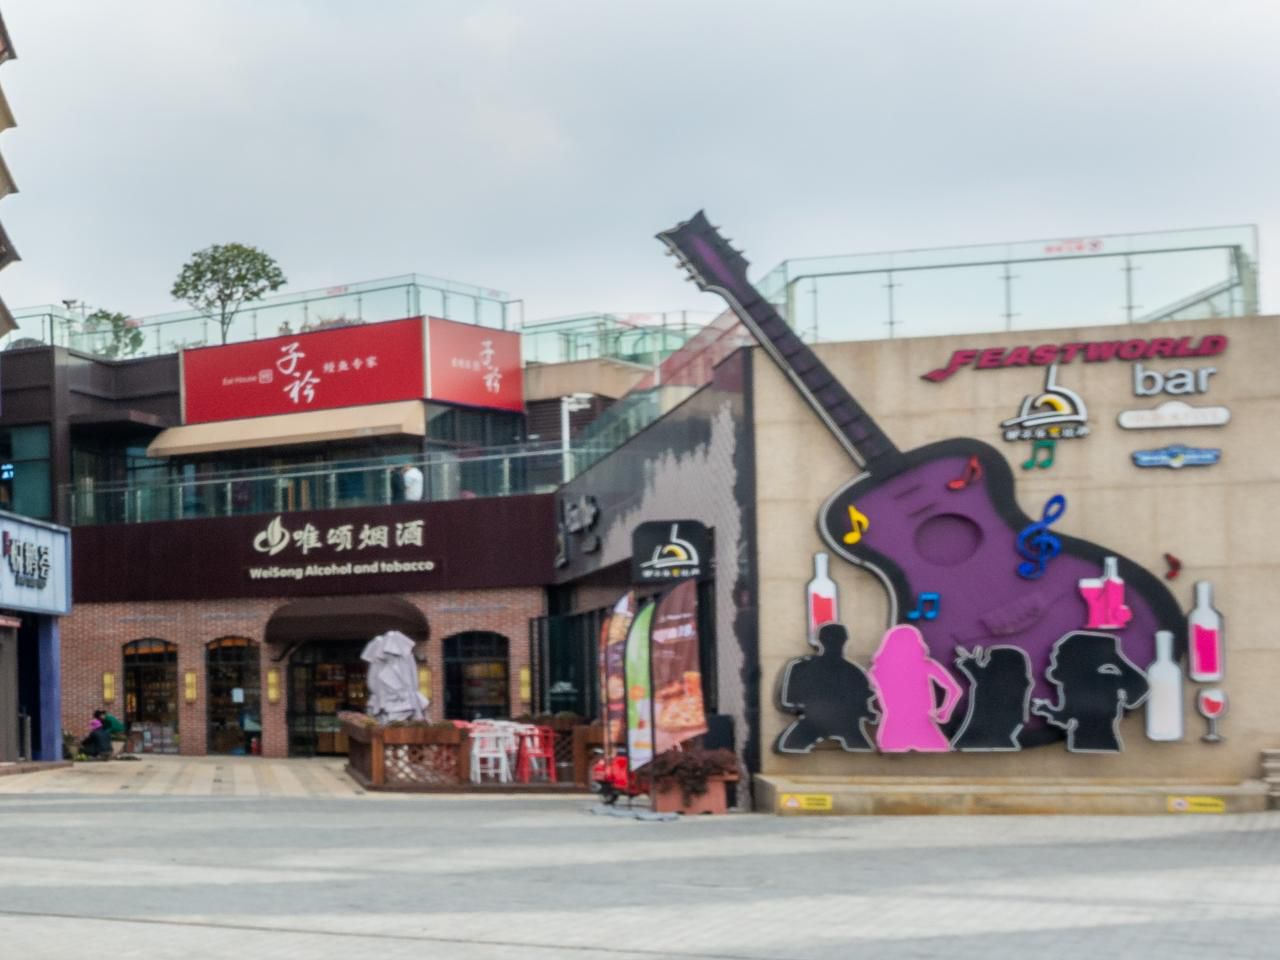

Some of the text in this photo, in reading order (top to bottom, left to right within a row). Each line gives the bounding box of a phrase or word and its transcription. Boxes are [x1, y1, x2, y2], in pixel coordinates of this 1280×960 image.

[920, 335, 1228, 383] FEASTWORLD
[1134, 362, 1217, 397] bar
[249, 559, 435, 580] WeiSong Alcohol and tobacco
